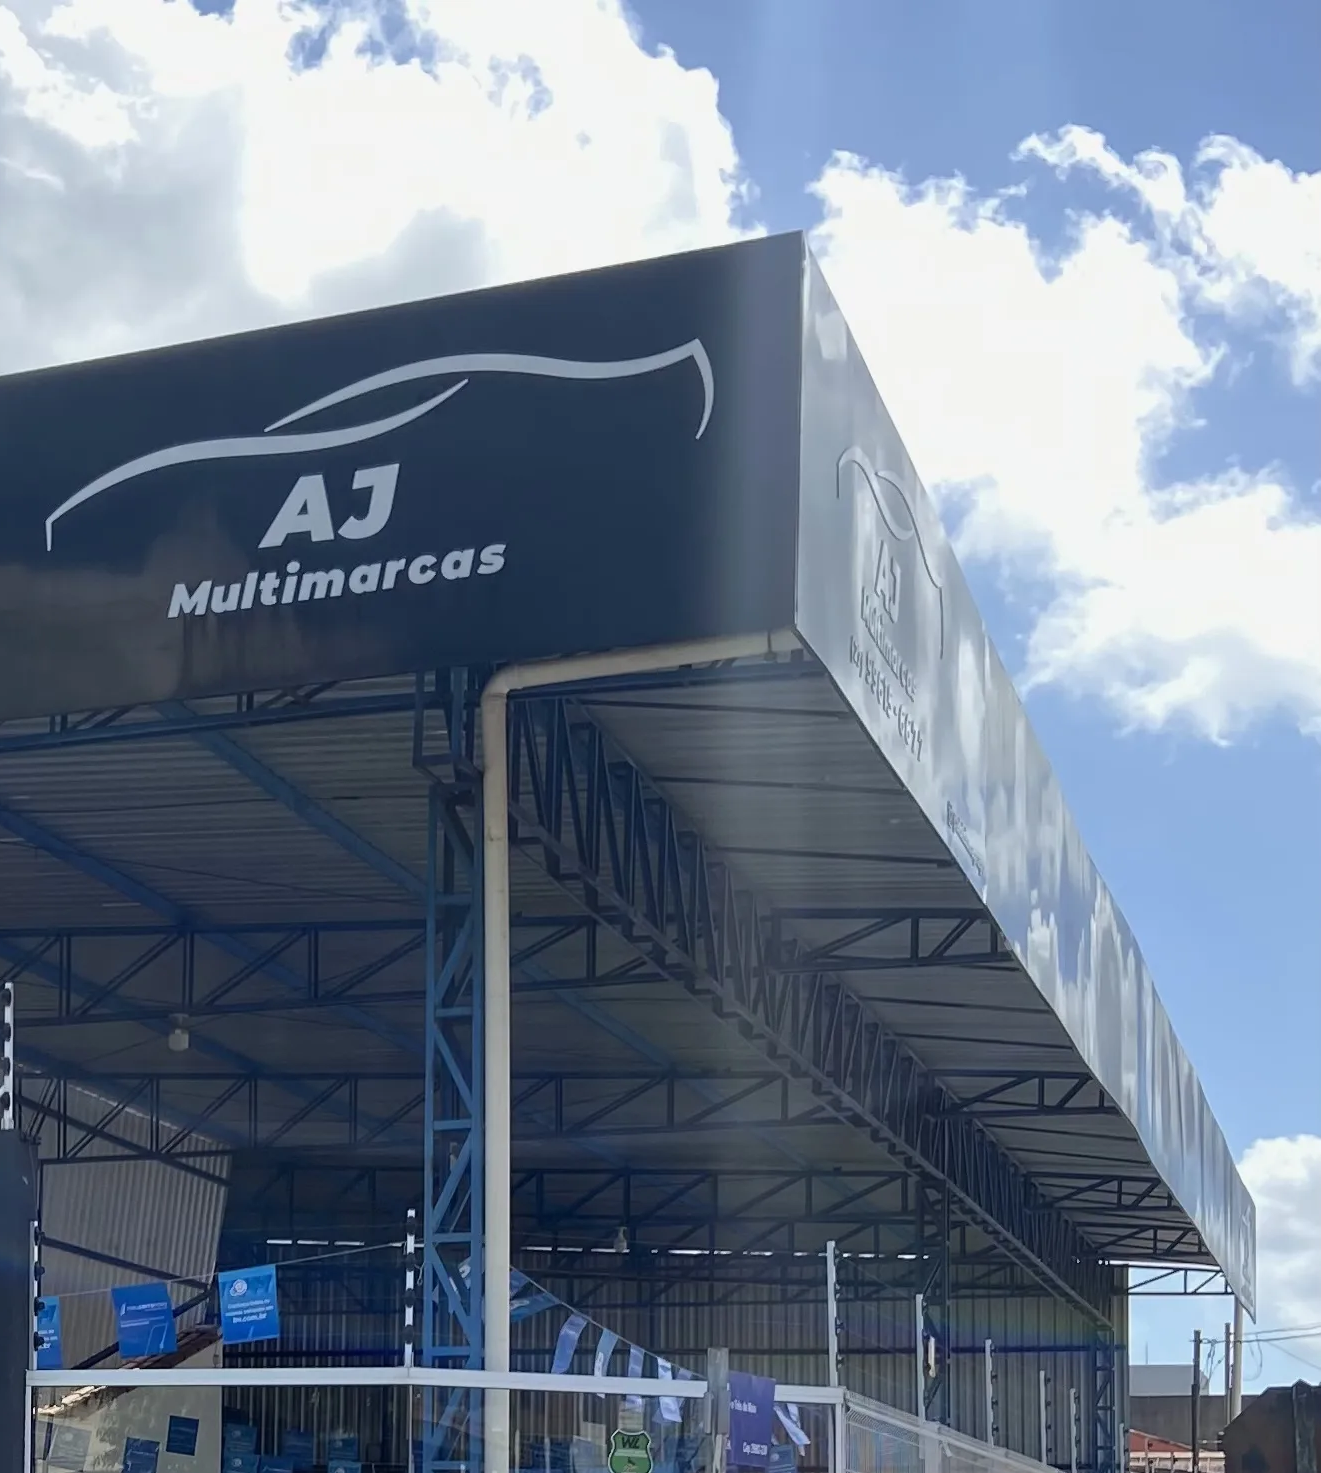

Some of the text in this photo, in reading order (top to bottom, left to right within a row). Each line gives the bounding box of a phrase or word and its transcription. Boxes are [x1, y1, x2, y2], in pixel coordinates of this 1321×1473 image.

[258, 463, 400, 549] AJ
[167, 543, 507, 619] Multimarcas
[874, 540, 901, 624] AJ
